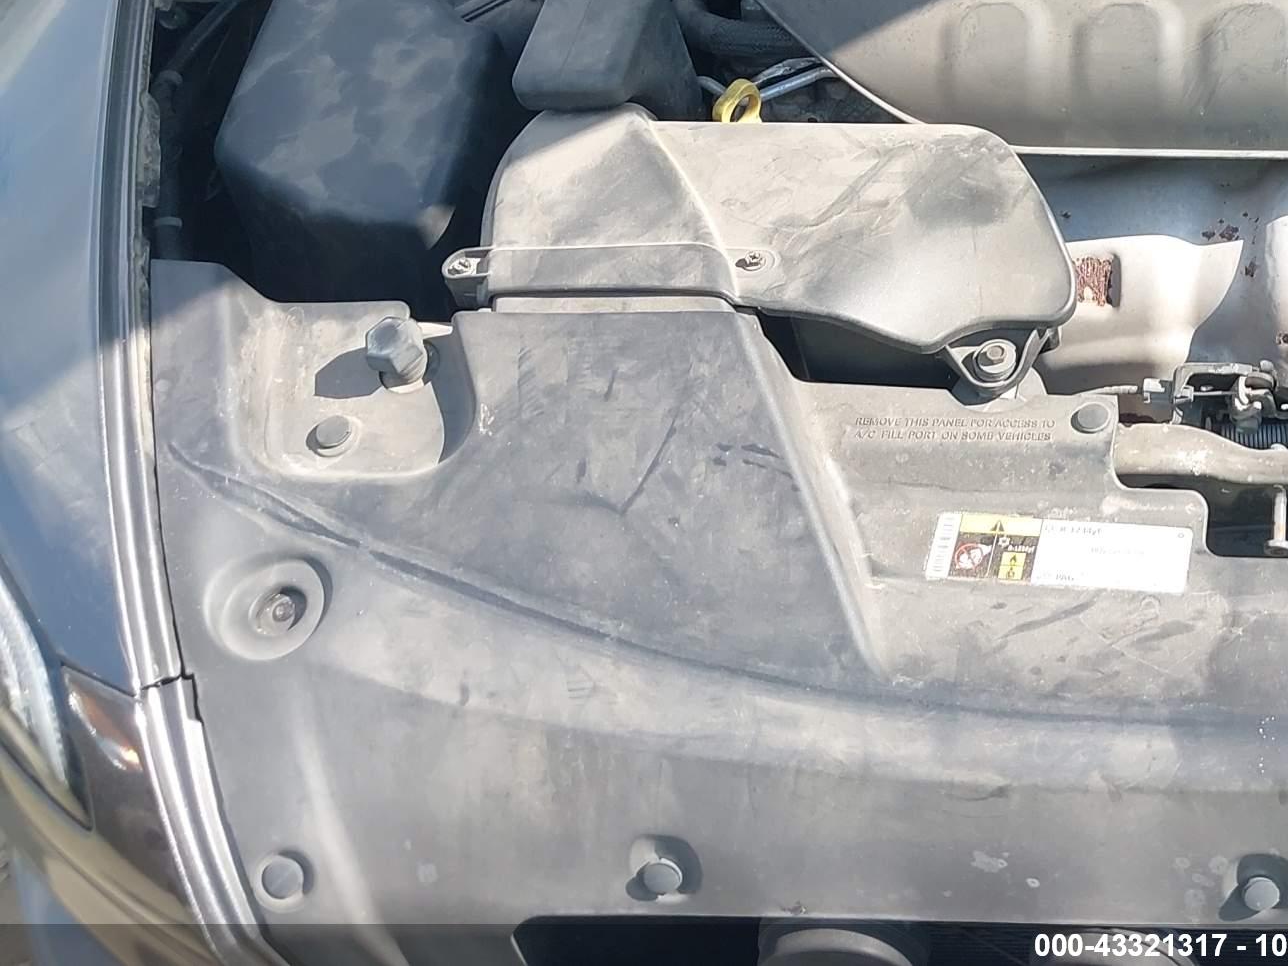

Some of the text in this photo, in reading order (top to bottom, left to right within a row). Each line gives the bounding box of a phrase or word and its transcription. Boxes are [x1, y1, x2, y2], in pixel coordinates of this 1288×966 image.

[855, 417, 1056, 429] REMOVE THIS PANEL FOR ACCESS TO
[855, 429, 1052, 442] A/C FILL PORT ON SOME VEHICLES
